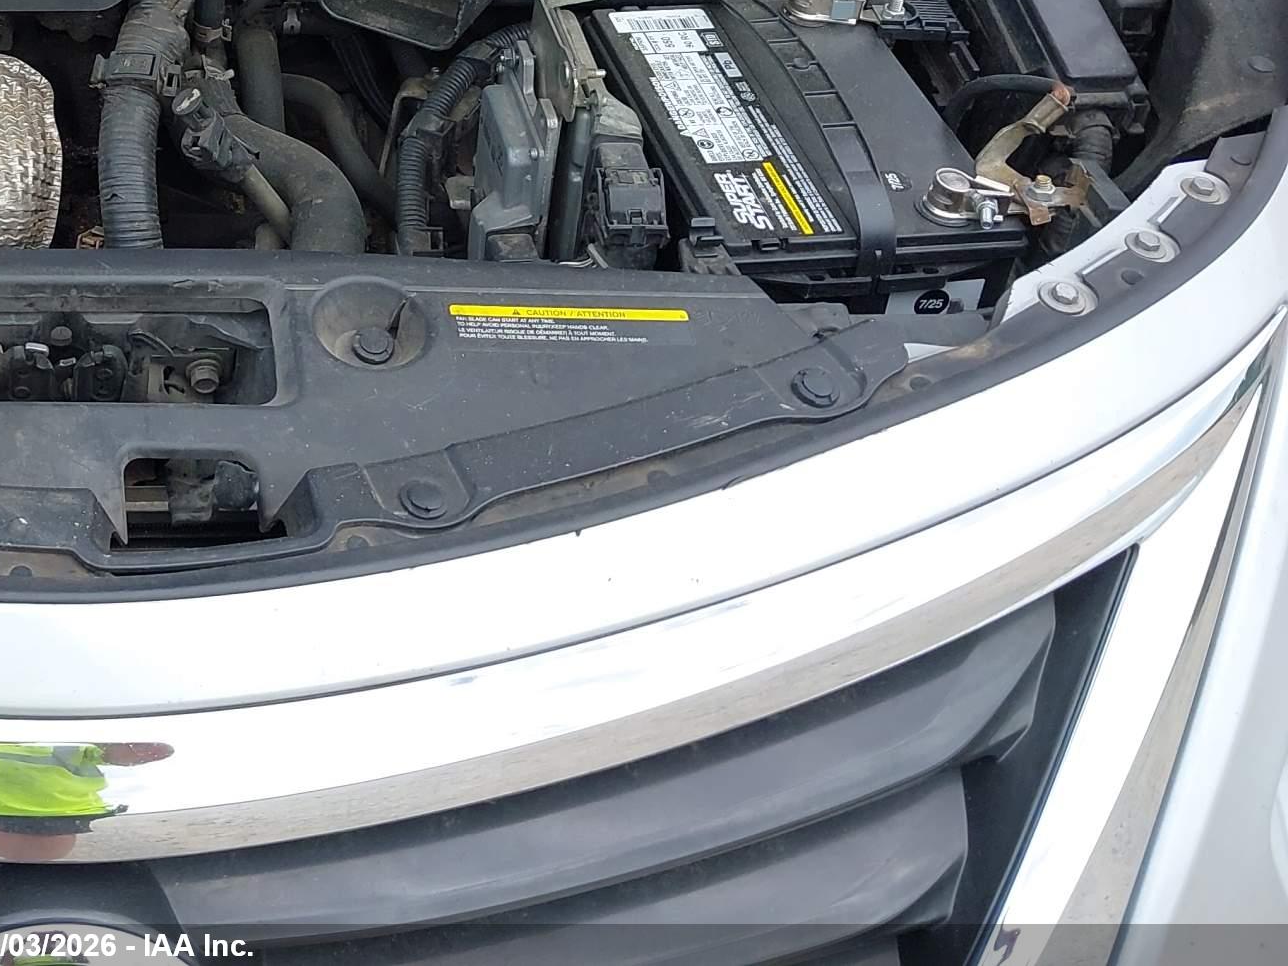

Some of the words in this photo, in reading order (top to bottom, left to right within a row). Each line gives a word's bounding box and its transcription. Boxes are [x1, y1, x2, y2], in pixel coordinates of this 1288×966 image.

[722, 57, 738, 75] Pb
[884, 172, 905, 191] 7/25
[714, 171, 749, 224] SUPER
[729, 175, 774, 231] START
[918, 298, 944, 309] 7/25
